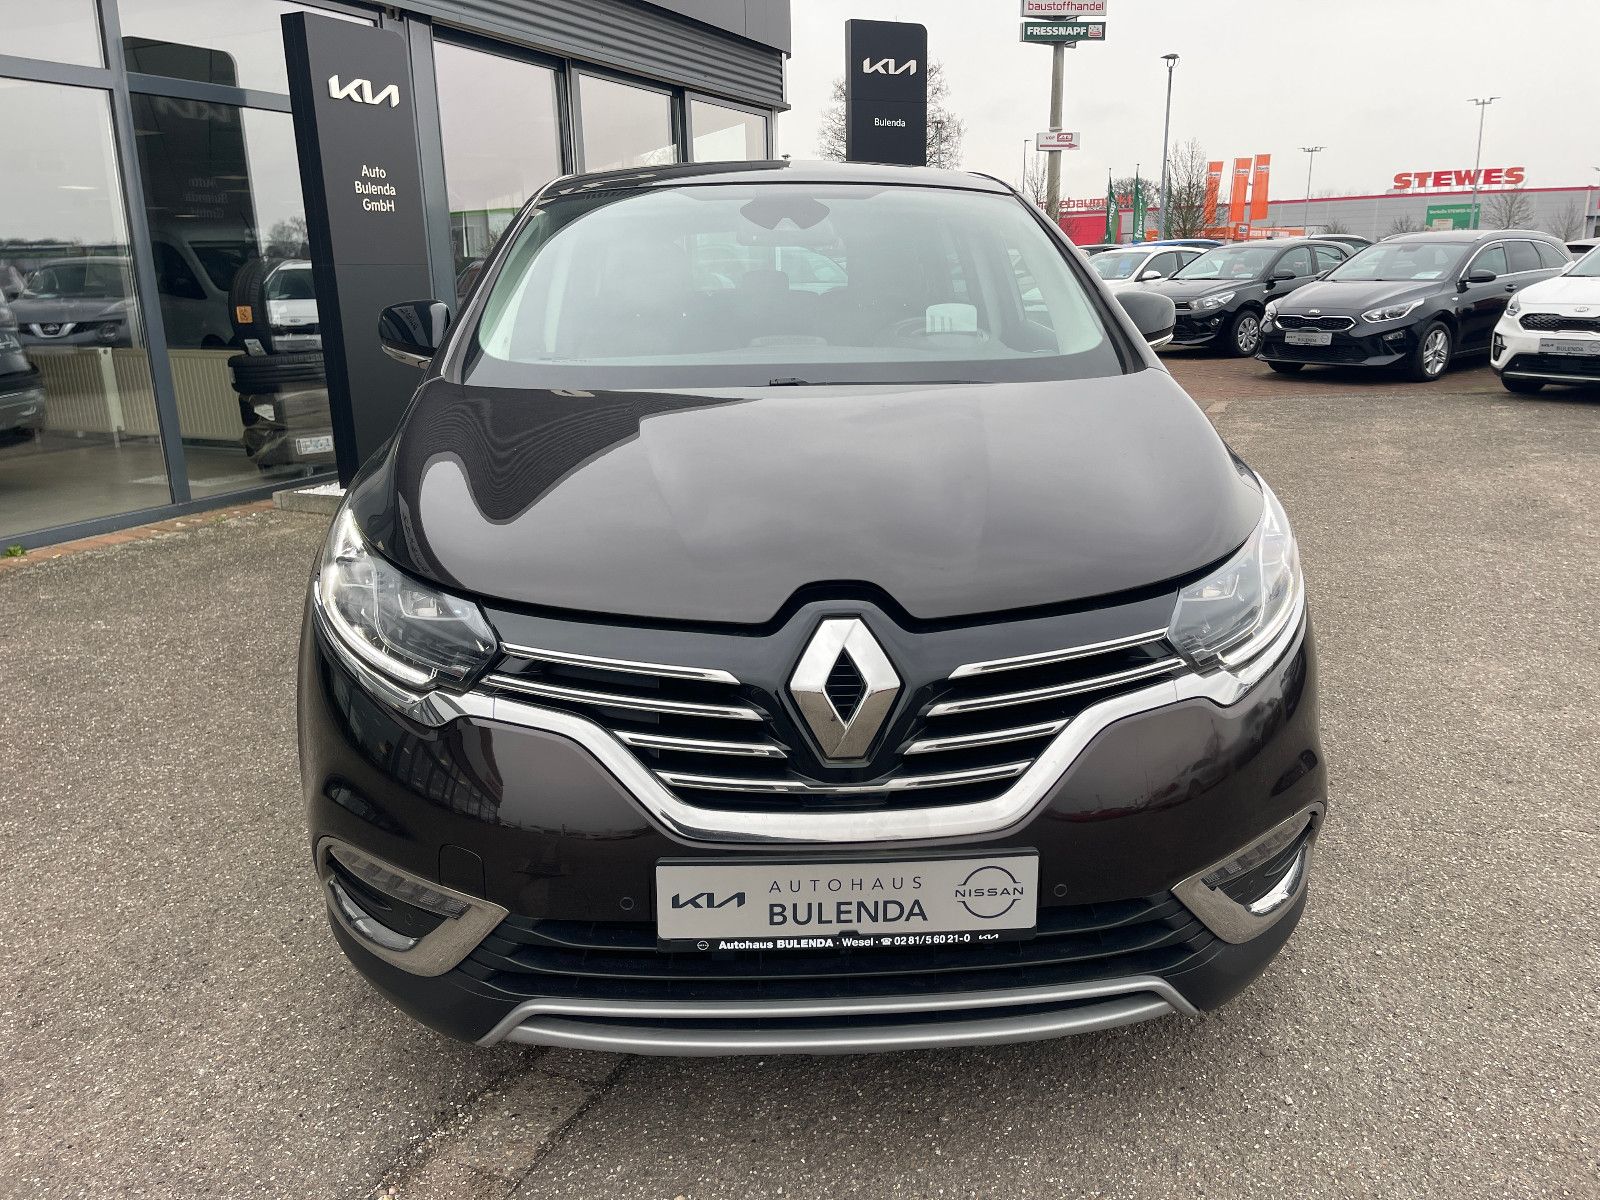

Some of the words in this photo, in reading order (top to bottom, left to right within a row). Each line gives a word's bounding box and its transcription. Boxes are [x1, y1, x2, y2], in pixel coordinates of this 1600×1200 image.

[1027, 1, 1104, 11] baustoffhandel
[1027, 26, 1087, 36] FRESSNAPF
[874, 117, 906, 128] Bulenda
[361, 164, 387, 179] Auto
[1393, 166, 1526, 190] STEWES
[354, 180, 397, 196] Bulenda
[362, 198, 396, 212] GmbH
[769, 876, 923, 893] AUTOHAUS
[954, 886, 1024, 898] NISSAN
[768, 899, 928, 926] BULENDA
[718, 940, 774, 950] Autohaus
[776, 938, 834, 949] BULENDA
[841, 937, 874, 947] Wesel
